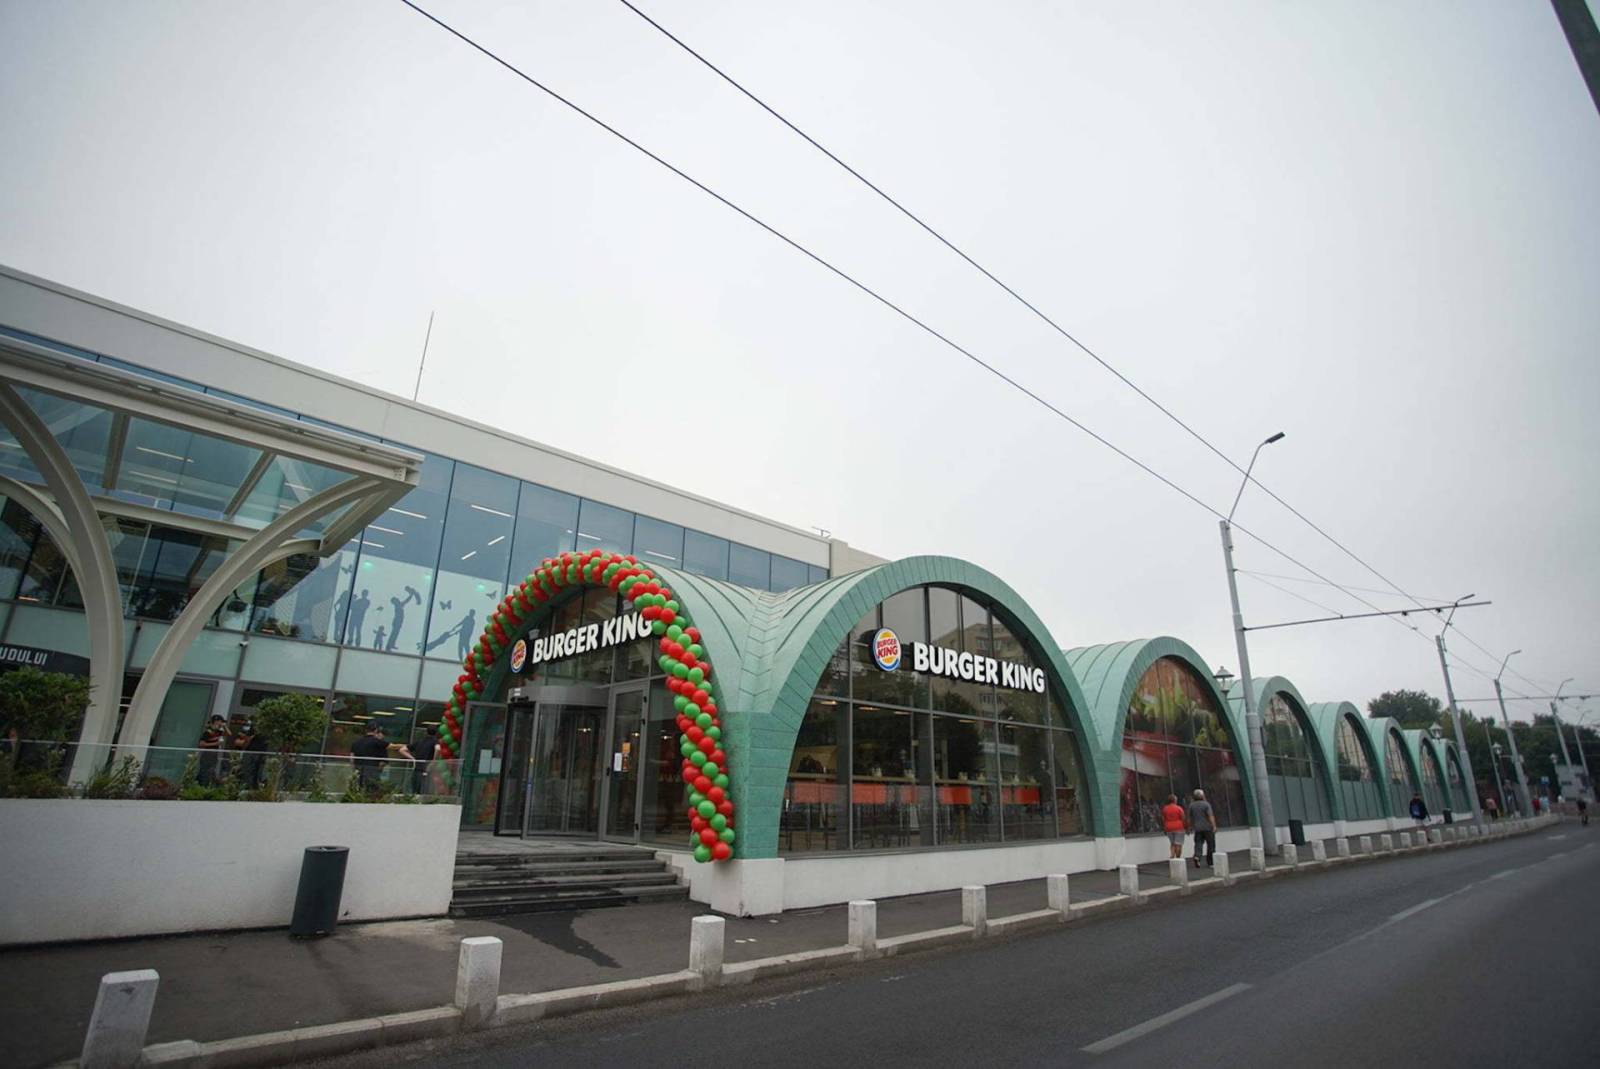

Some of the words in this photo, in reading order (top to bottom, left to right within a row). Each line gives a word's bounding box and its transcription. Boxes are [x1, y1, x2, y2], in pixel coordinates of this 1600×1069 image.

[532, 624, 598, 664] BURGER
[602, 612, 652, 647] KING
[877, 638, 897, 648] BURGER
[878, 645, 898, 658] KING
[914, 642, 999, 685] BURGER
[1002, 661, 1046, 693] KING
